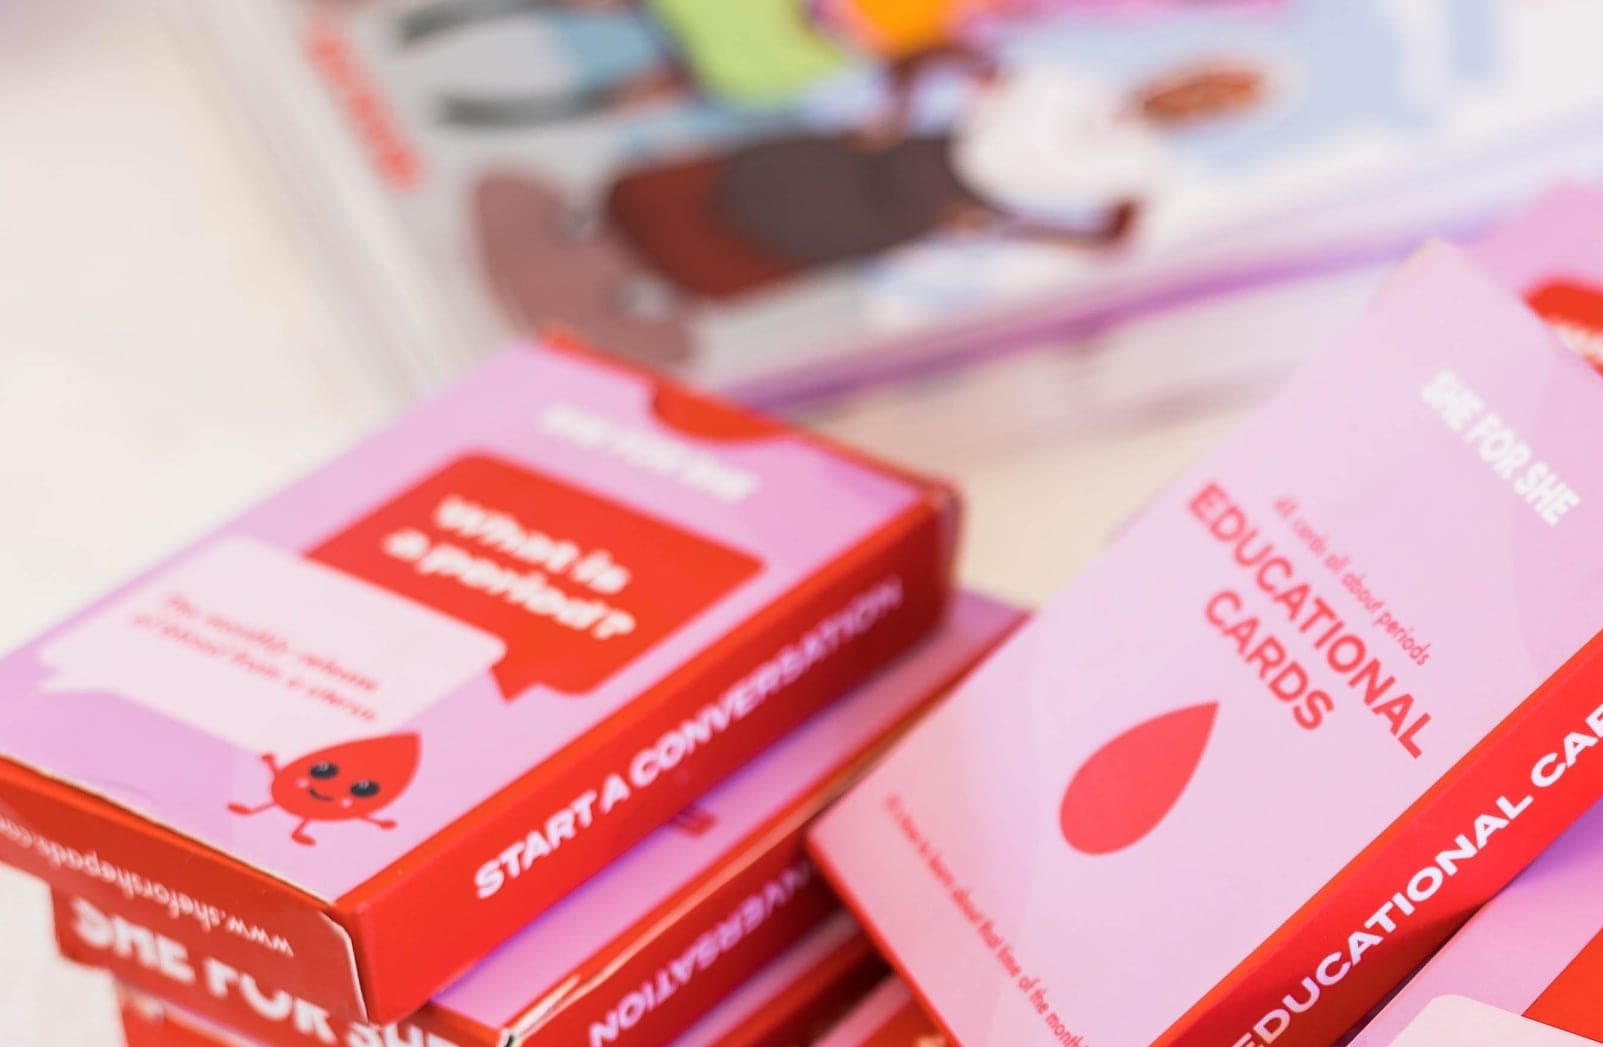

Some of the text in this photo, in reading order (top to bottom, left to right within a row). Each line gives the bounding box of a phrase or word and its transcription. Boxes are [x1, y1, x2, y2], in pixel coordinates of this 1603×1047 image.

[1421, 369, 1581, 527] SHE FOR SHE
[383, 529, 635, 639] a period?
[436, 495, 631, 593] What is
[1188, 482, 1432, 759] EDUCATIONAL
[1205, 589, 1335, 731] CARDS
[1374, 611, 1431, 666] periods
[475, 576, 902, 899] START A CONVERSATION
[1030, 987, 1049, 1015] the
